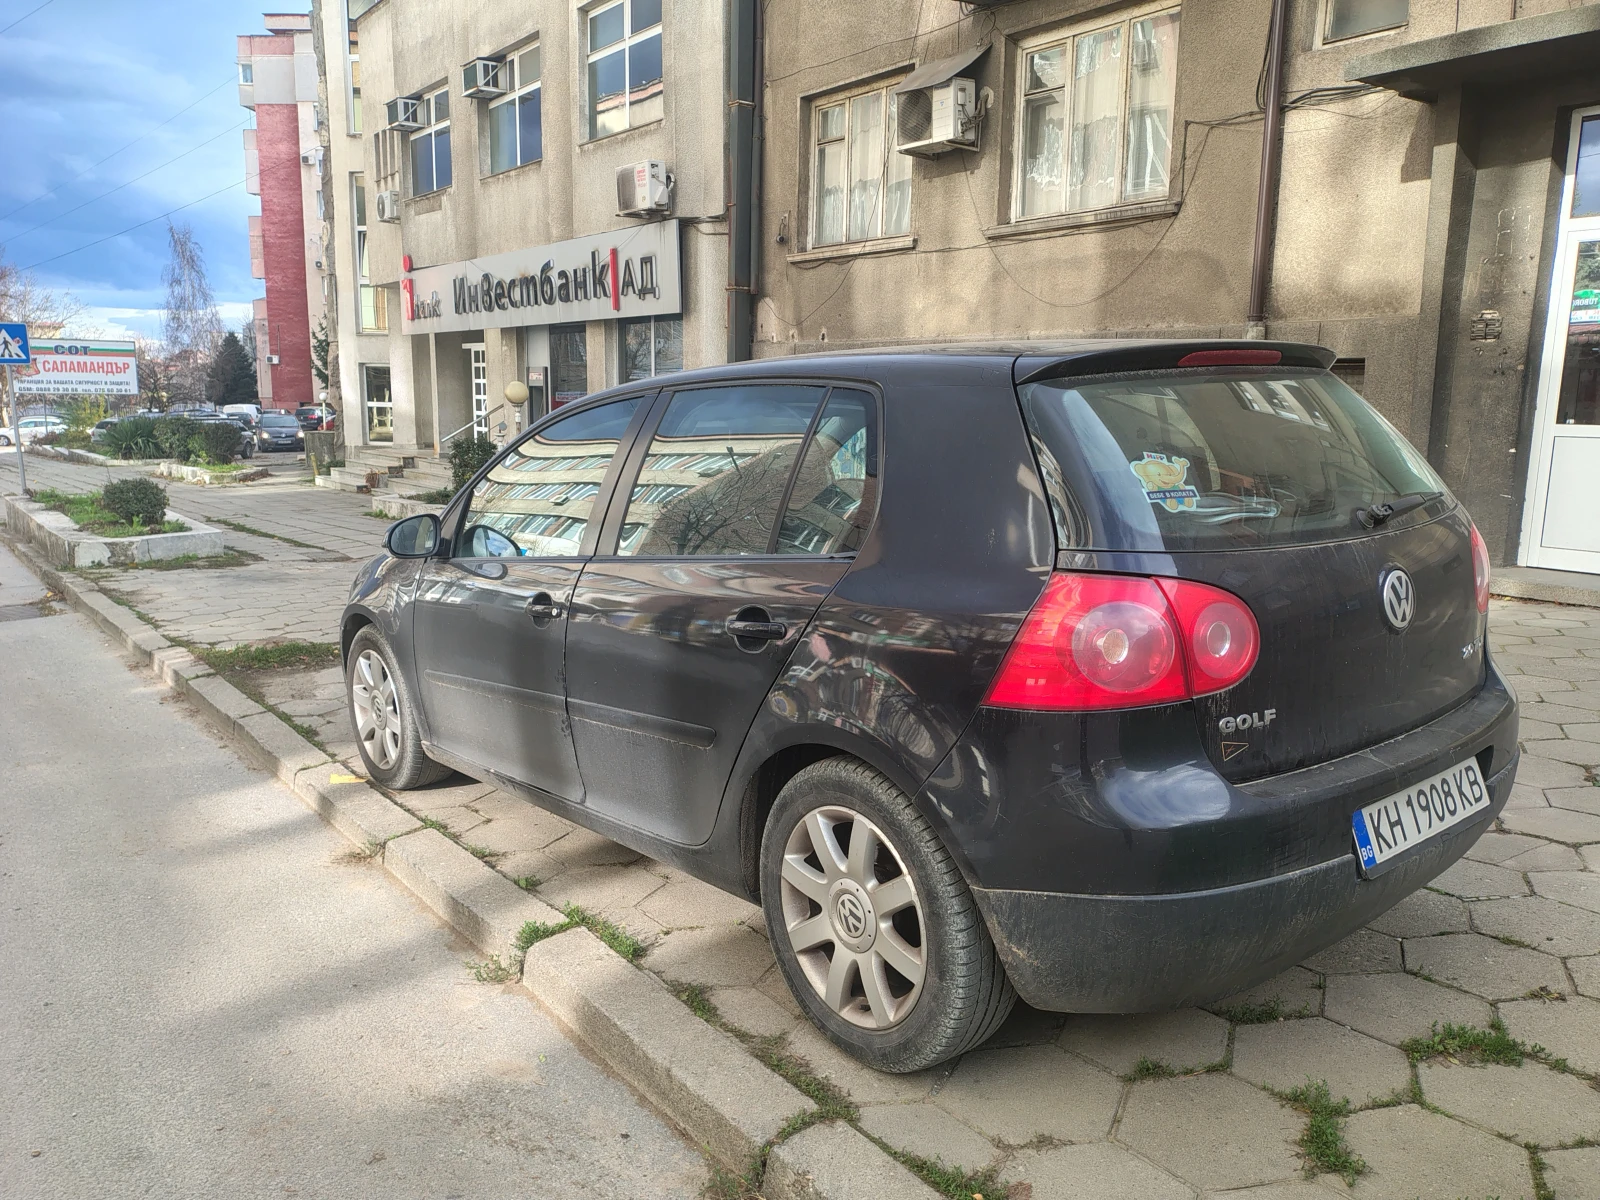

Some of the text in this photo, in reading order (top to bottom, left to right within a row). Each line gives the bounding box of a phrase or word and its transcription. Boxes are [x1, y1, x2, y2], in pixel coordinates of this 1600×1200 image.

[53, 344, 91, 356] СОТ
[42, 360, 130, 376] САЛАМАНДЪР
[1218, 708, 1277, 734] GOLF
[1360, 845, 1374, 861] BG
